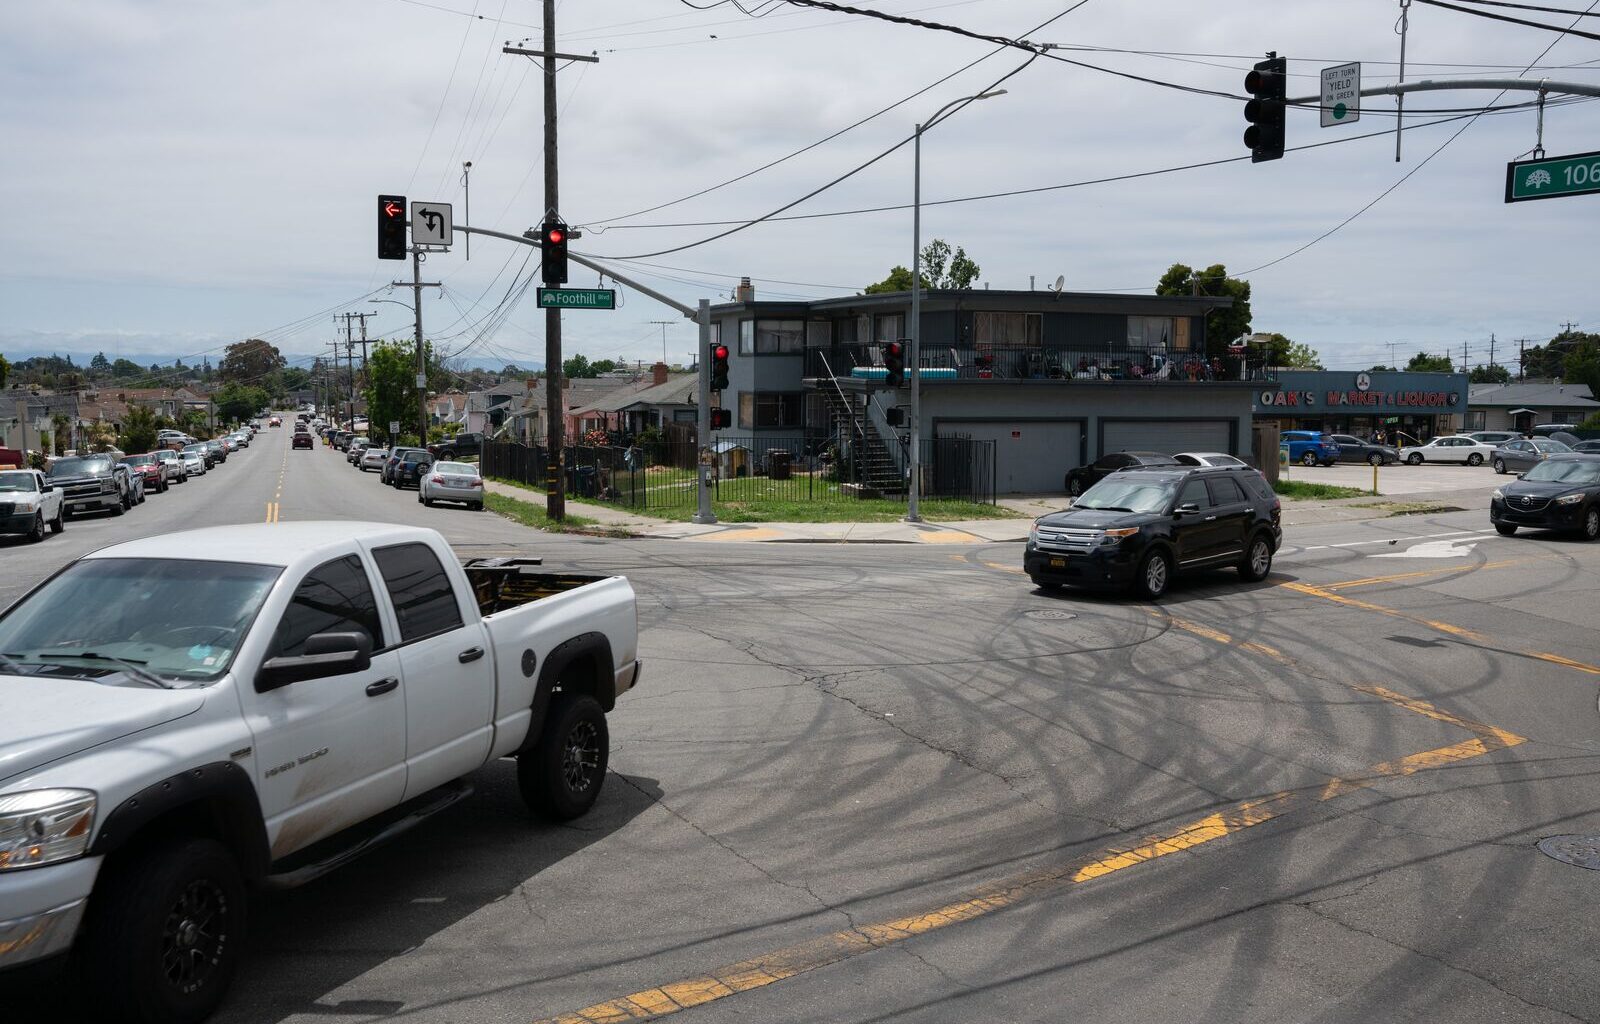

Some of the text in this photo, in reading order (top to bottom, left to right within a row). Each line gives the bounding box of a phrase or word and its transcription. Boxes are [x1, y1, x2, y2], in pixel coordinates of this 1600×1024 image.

[1325, 68, 1356, 81] LEFT TURN
[1325, 90, 1355, 102] ON GREEN
[556, 293, 596, 304] Foothill
[1261, 391, 1314, 405] OAK'S
[1327, 391, 1384, 406] MARKET
[1396, 391, 1447, 406] LIQUOR
